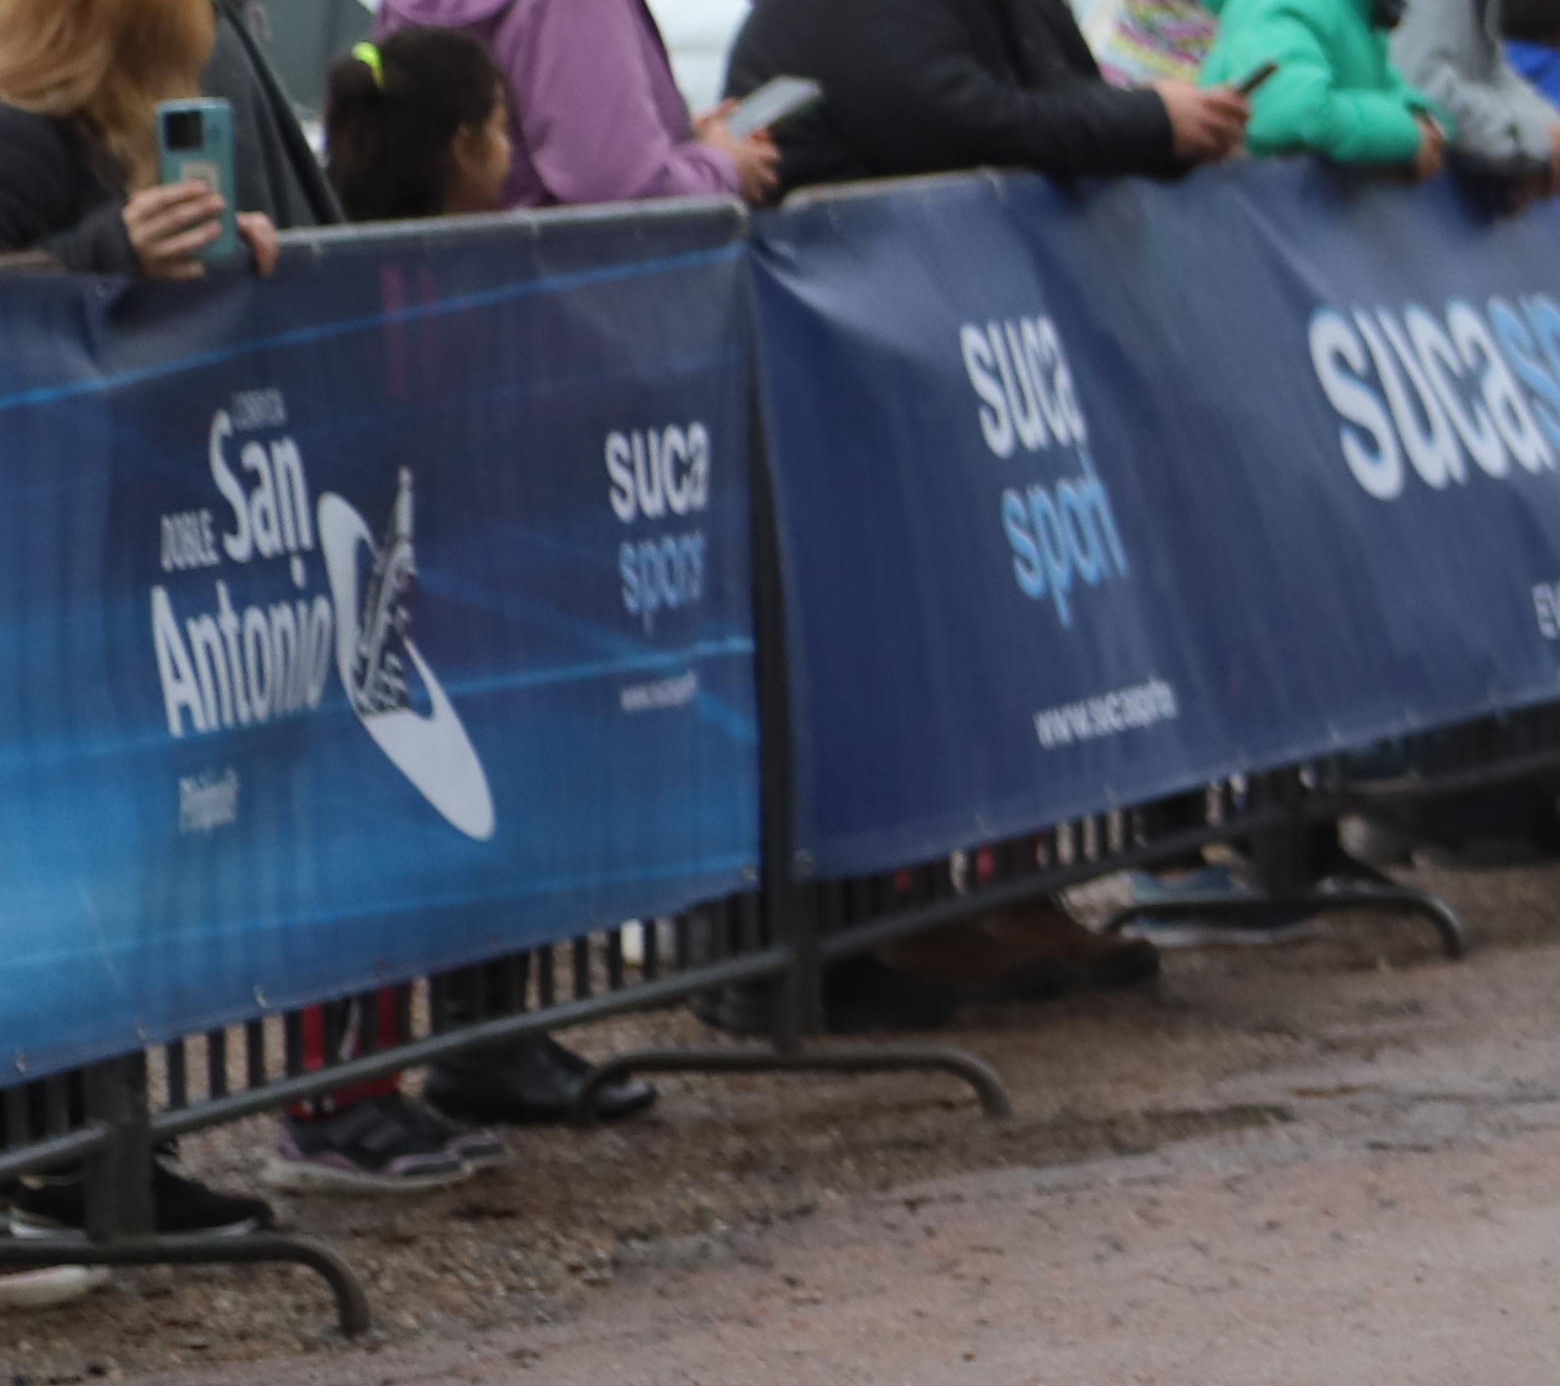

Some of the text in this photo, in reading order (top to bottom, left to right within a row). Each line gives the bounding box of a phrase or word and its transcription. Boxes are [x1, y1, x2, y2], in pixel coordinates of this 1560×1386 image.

[960, 315, 1088, 459] suca
[209, 408, 314, 564] San
[604, 421, 710, 524] suca
[152, 553, 332, 739] Antonio
